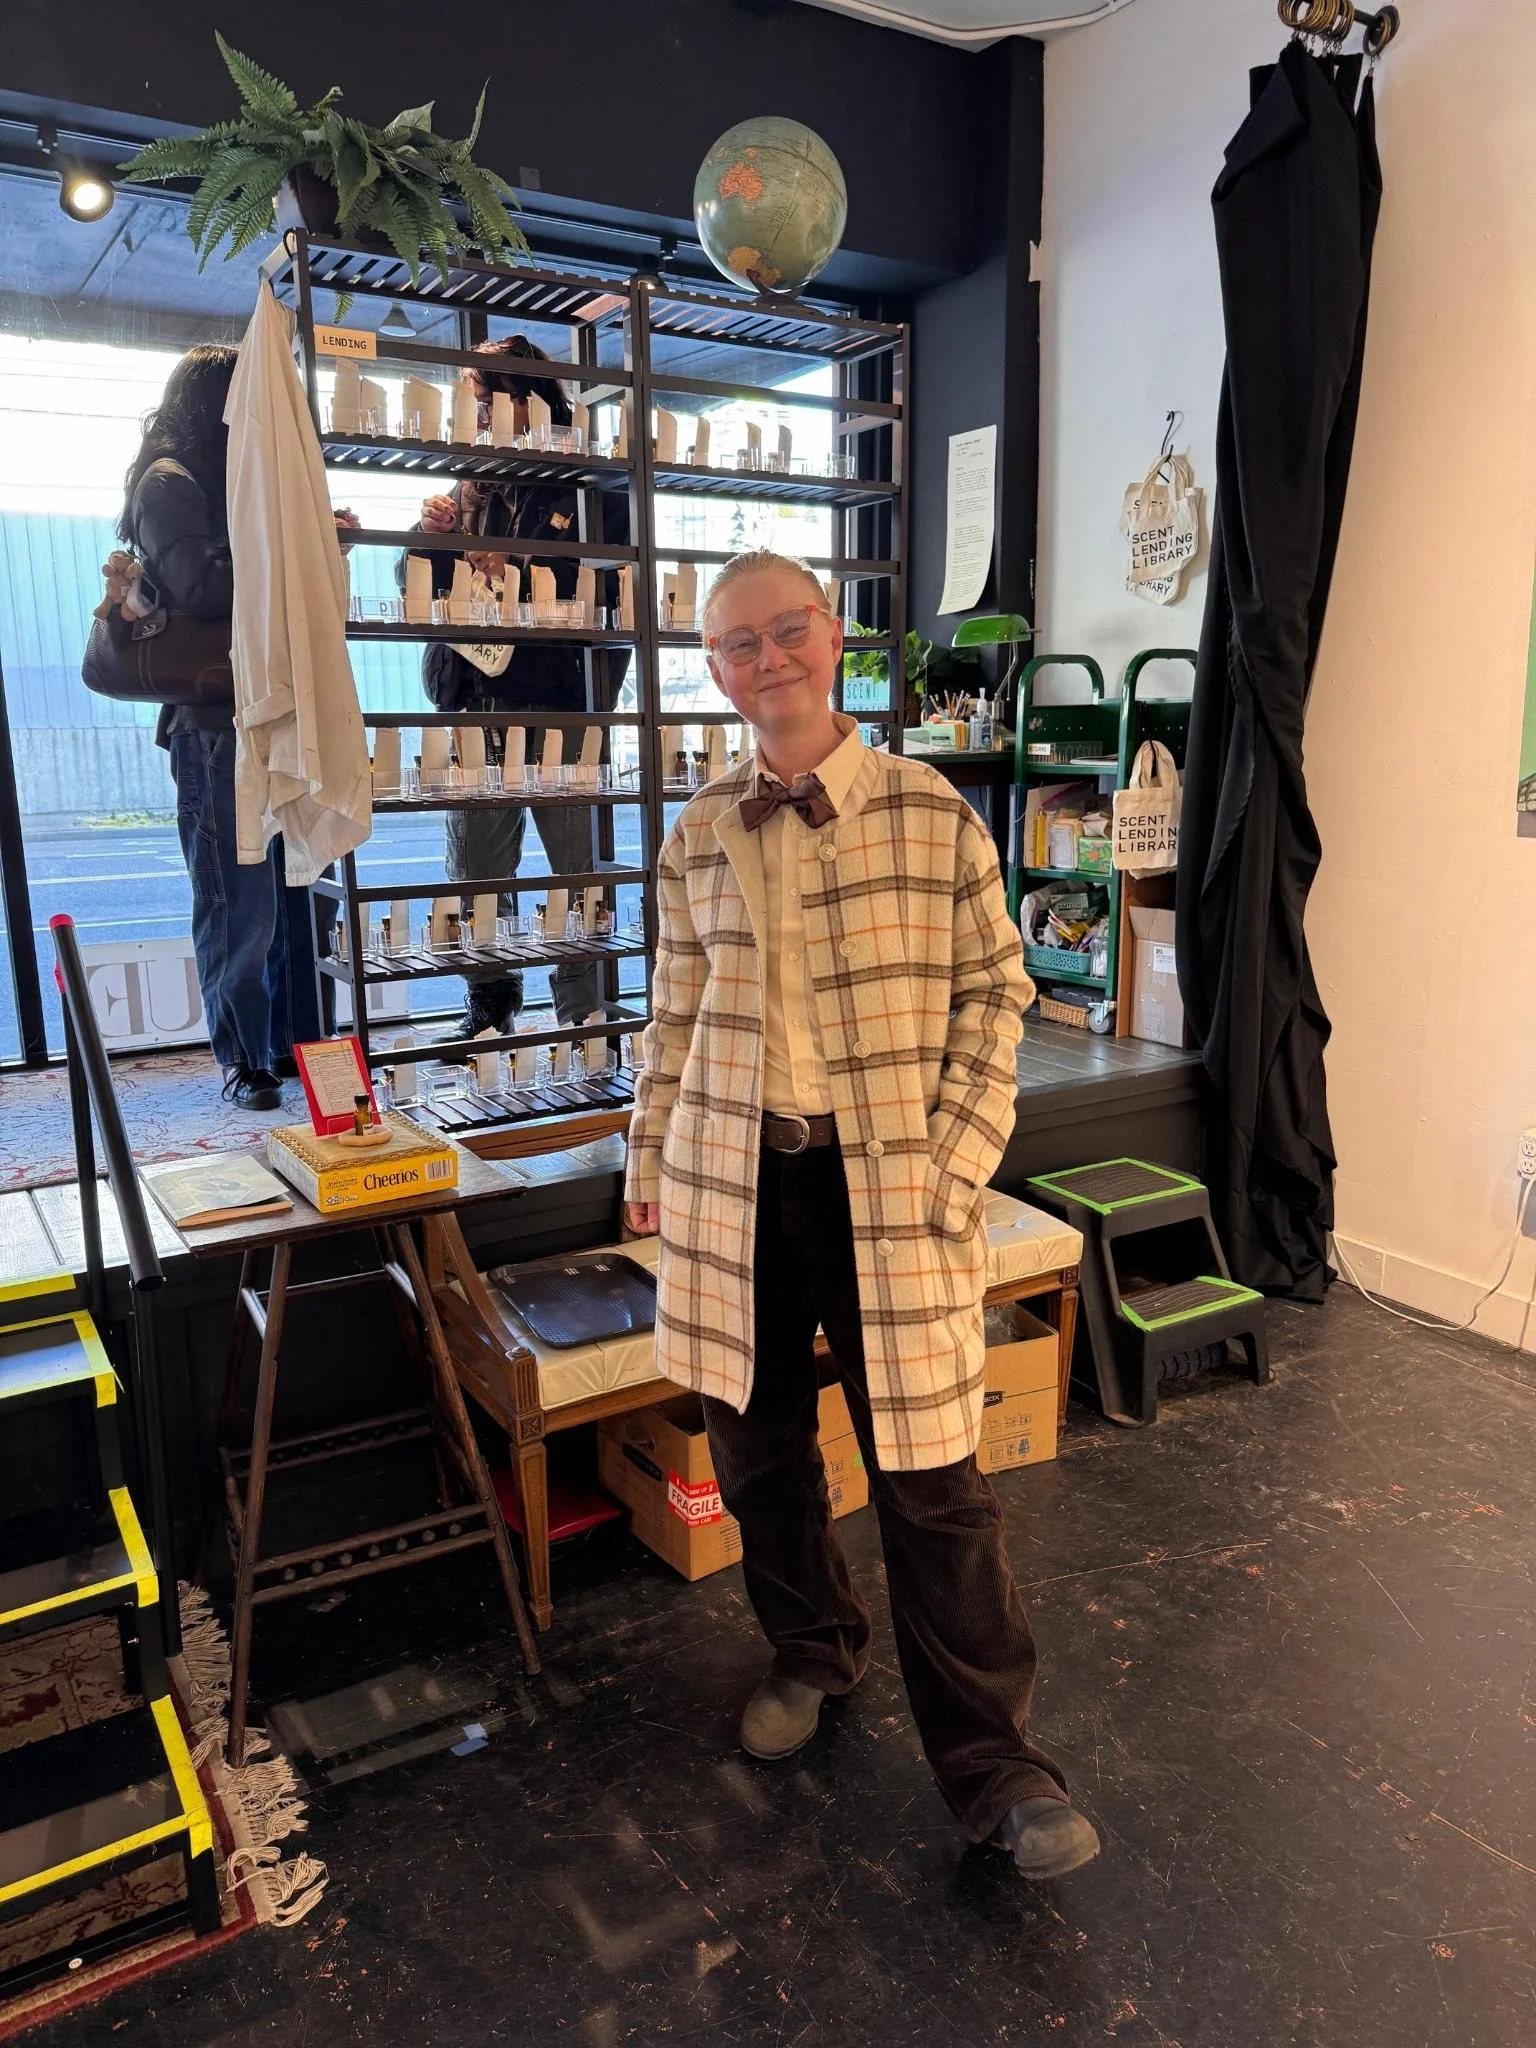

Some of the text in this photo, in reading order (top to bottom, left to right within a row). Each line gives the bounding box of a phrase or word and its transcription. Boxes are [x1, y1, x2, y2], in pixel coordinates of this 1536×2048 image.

[322, 335, 367, 350] LENDING
[1132, 525, 1174, 544] SCENT
[1132, 532, 1193, 556] LENDING
[1132, 544, 1192, 569] LIBRARY
[1119, 814, 1167, 827] SCENT
[1118, 827, 1177, 840] LENDIN
[1118, 840, 1177, 853] LIBRAR
[364, 1169, 419, 1191] Cheerios
[671, 1489, 720, 1516] FRAGILE
